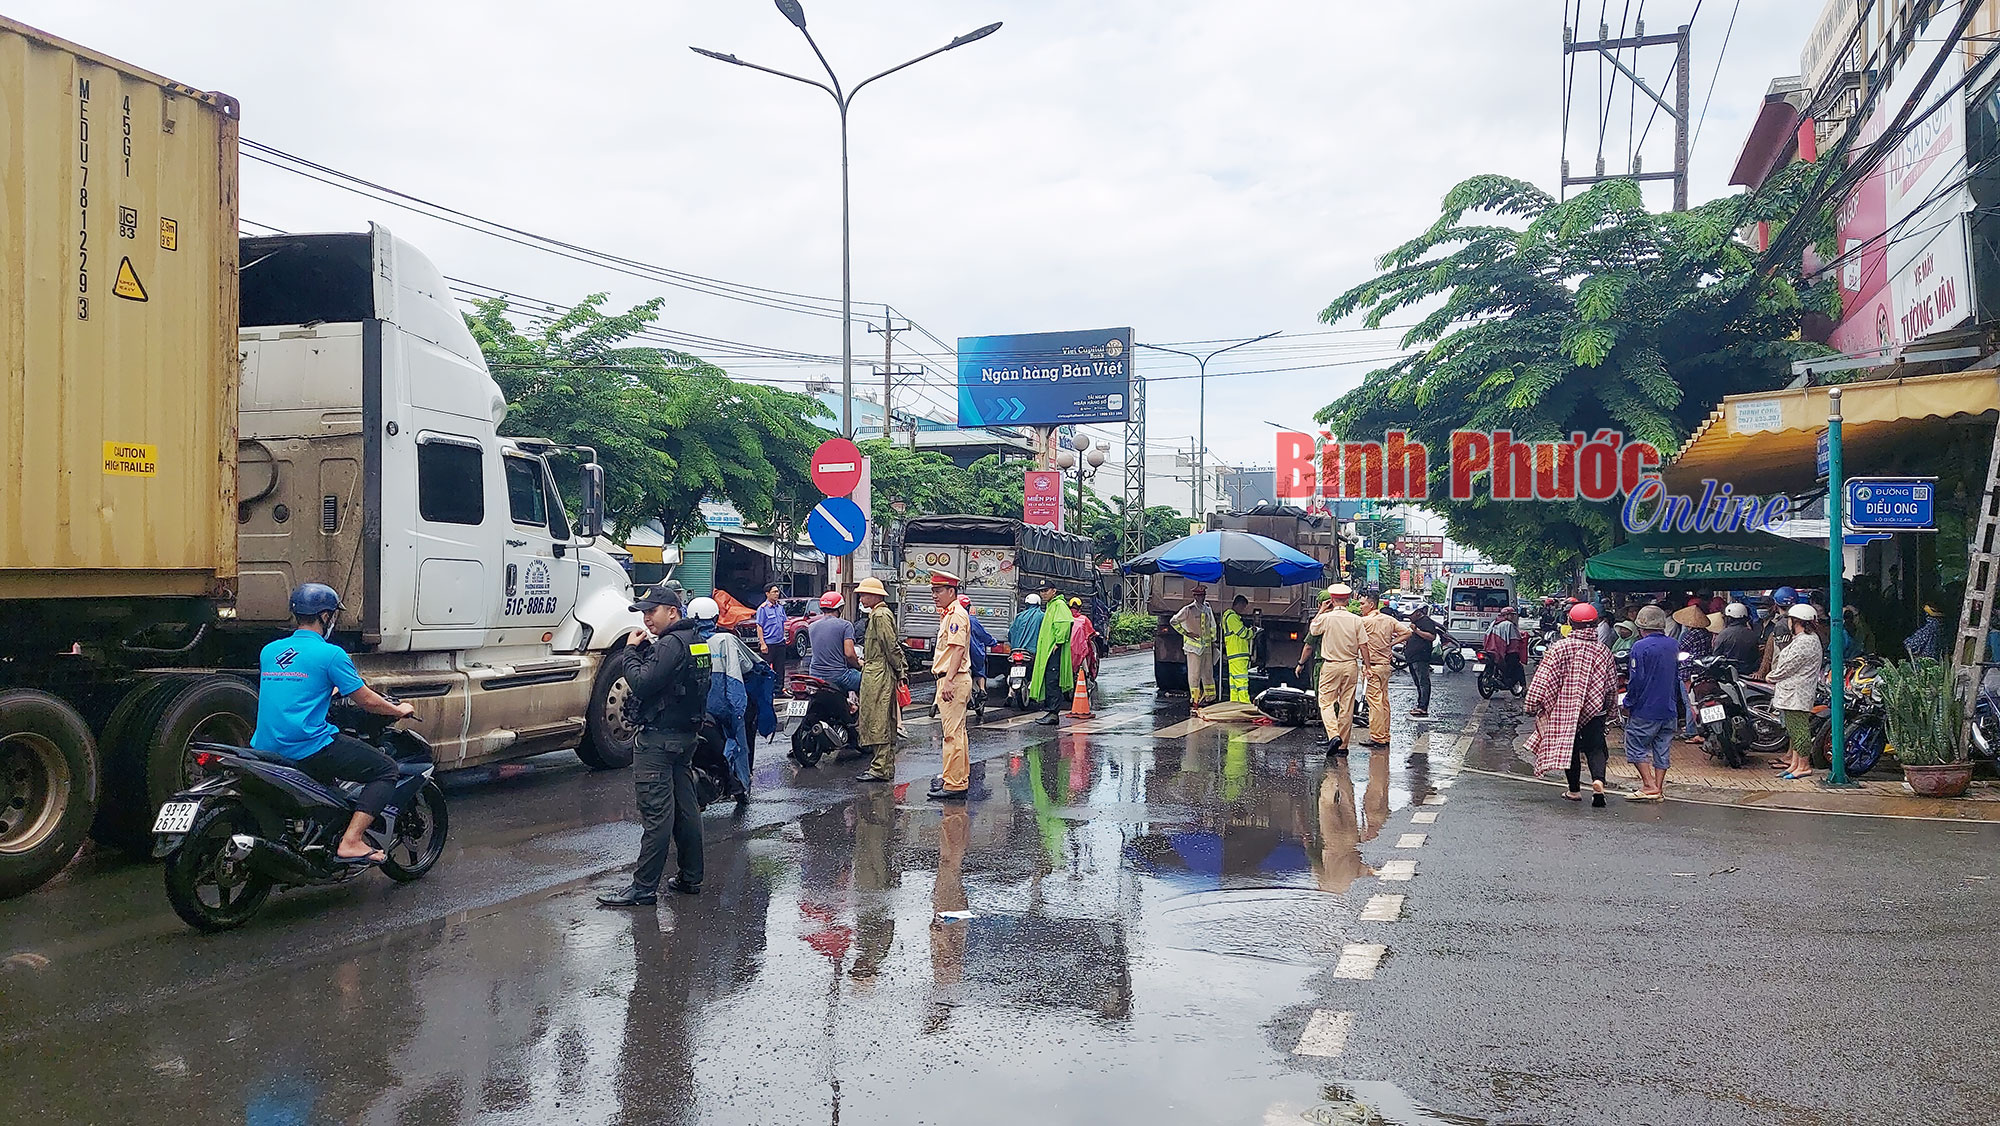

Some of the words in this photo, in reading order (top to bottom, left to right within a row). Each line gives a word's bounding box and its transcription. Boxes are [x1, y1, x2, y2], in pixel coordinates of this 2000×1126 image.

[123, 95, 131, 177] 45G1
[120, 226, 135, 239] 83
[1914, 265, 1921, 286] XE
[1901, 297, 1933, 342] TƯỜNG
[1934, 276, 1956, 319] VÂN
[982, 367, 1020, 384] Ngân
[1022, 364, 1060, 382] hàng
[1061, 363, 1091, 378] Bản
[1094, 361, 1123, 377] Việt
[120, 461, 155, 473] TRAILER
[1875, 486, 1909, 496] ĐƯỜNG
[1866, 498, 1891, 514] ĐIỂU
[1894, 503, 1918, 514] ONG
[1686, 561, 1713, 573] TRẢ
[1717, 560, 1762, 572] TRƯỚC
[1457, 577, 1505, 587] AMBULANCE
[505, 597, 557, 616] 51C-886.63
[164, 803, 193, 817] 93-P2
[155, 817, 190, 831] 267.24
